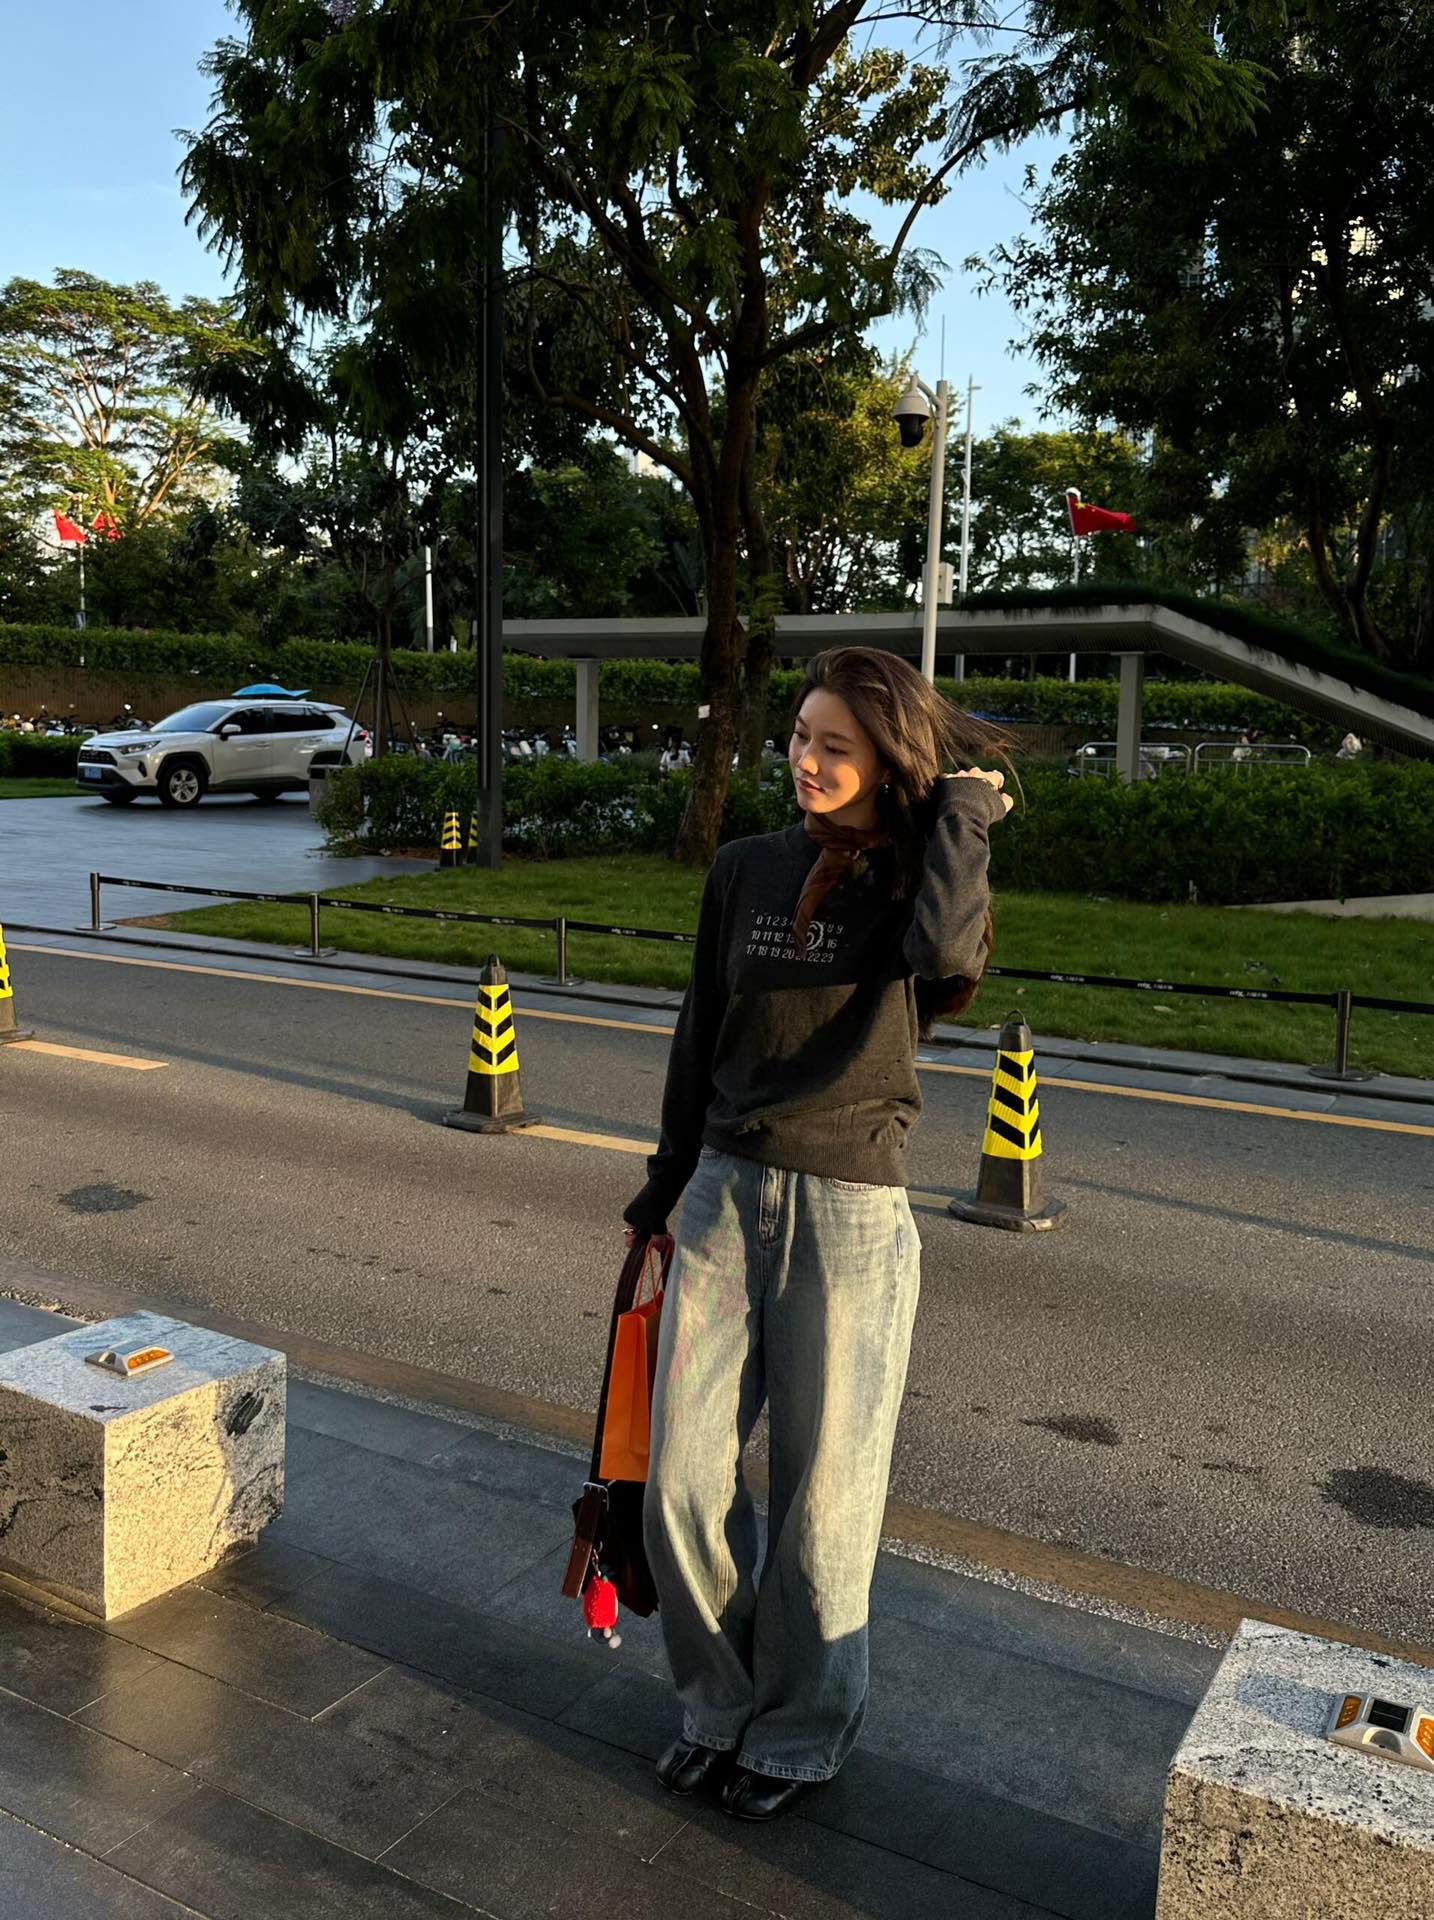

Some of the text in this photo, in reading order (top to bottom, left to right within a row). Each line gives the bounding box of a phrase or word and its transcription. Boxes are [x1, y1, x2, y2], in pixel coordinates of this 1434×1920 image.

[766, 915, 772, 926] 1
[772, 916, 780, 926] 2
[780, 916, 788, 927] 3
[751, 929, 761, 941] 10
[762, 931, 772, 941] 11
[774, 931, 784, 943] 12
[827, 938, 838, 949] 16
[746, 944, 757, 955] 17
[757, 945, 769, 956] 18
[770, 946, 781, 958] 19
[781, 948, 795, 960] 20
[807, 951, 821, 963] 22
[820, 952, 834, 963] 23
